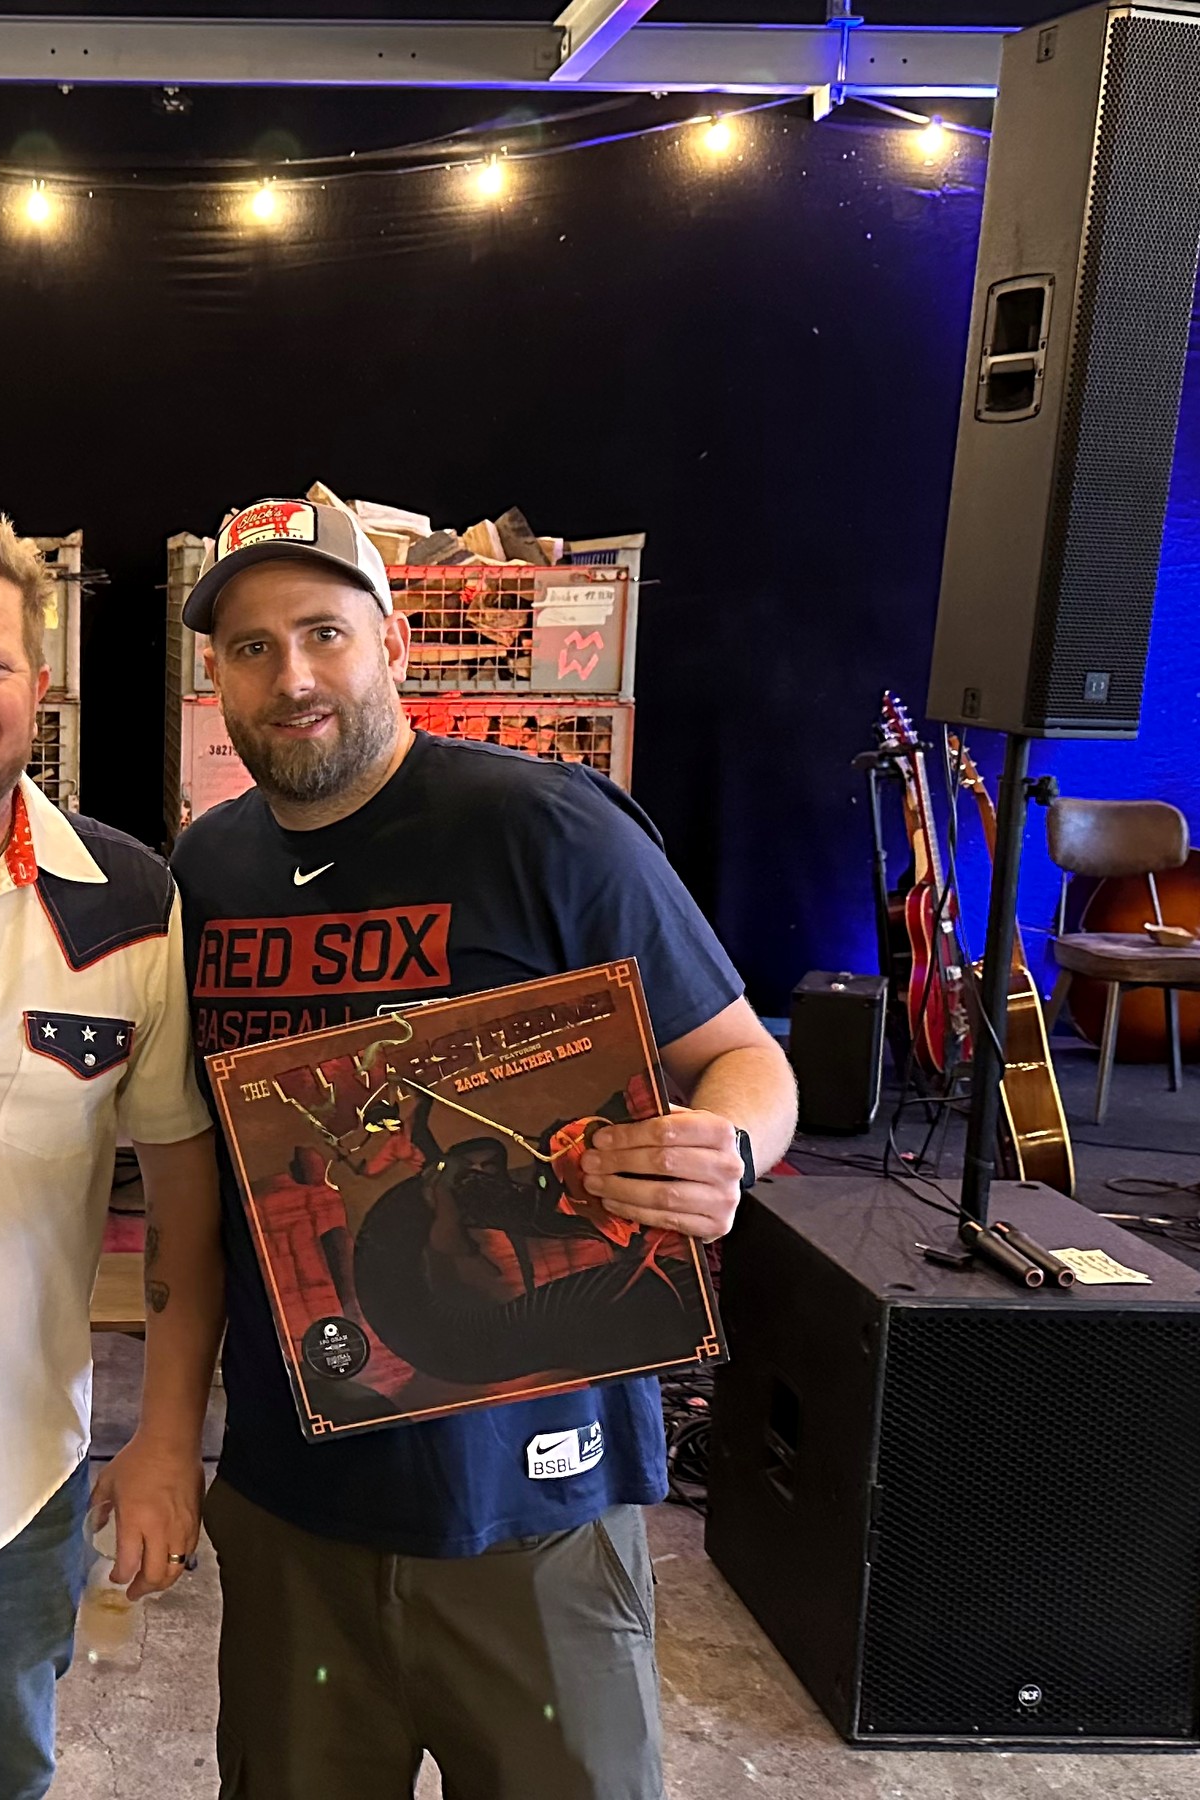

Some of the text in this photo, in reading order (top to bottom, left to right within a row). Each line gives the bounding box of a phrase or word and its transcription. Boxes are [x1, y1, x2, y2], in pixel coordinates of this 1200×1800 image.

[208, 743, 236, 757] 3821
[200, 913, 441, 989] RED SOX
[498, 1043, 542, 1062] FEATURING
[453, 1037, 593, 1093] ZACK WALTHER BAND
[239, 1079, 271, 1102] THE
[533, 1456, 577, 1476] BSBL
[1021, 1690, 1040, 1701] RCF
